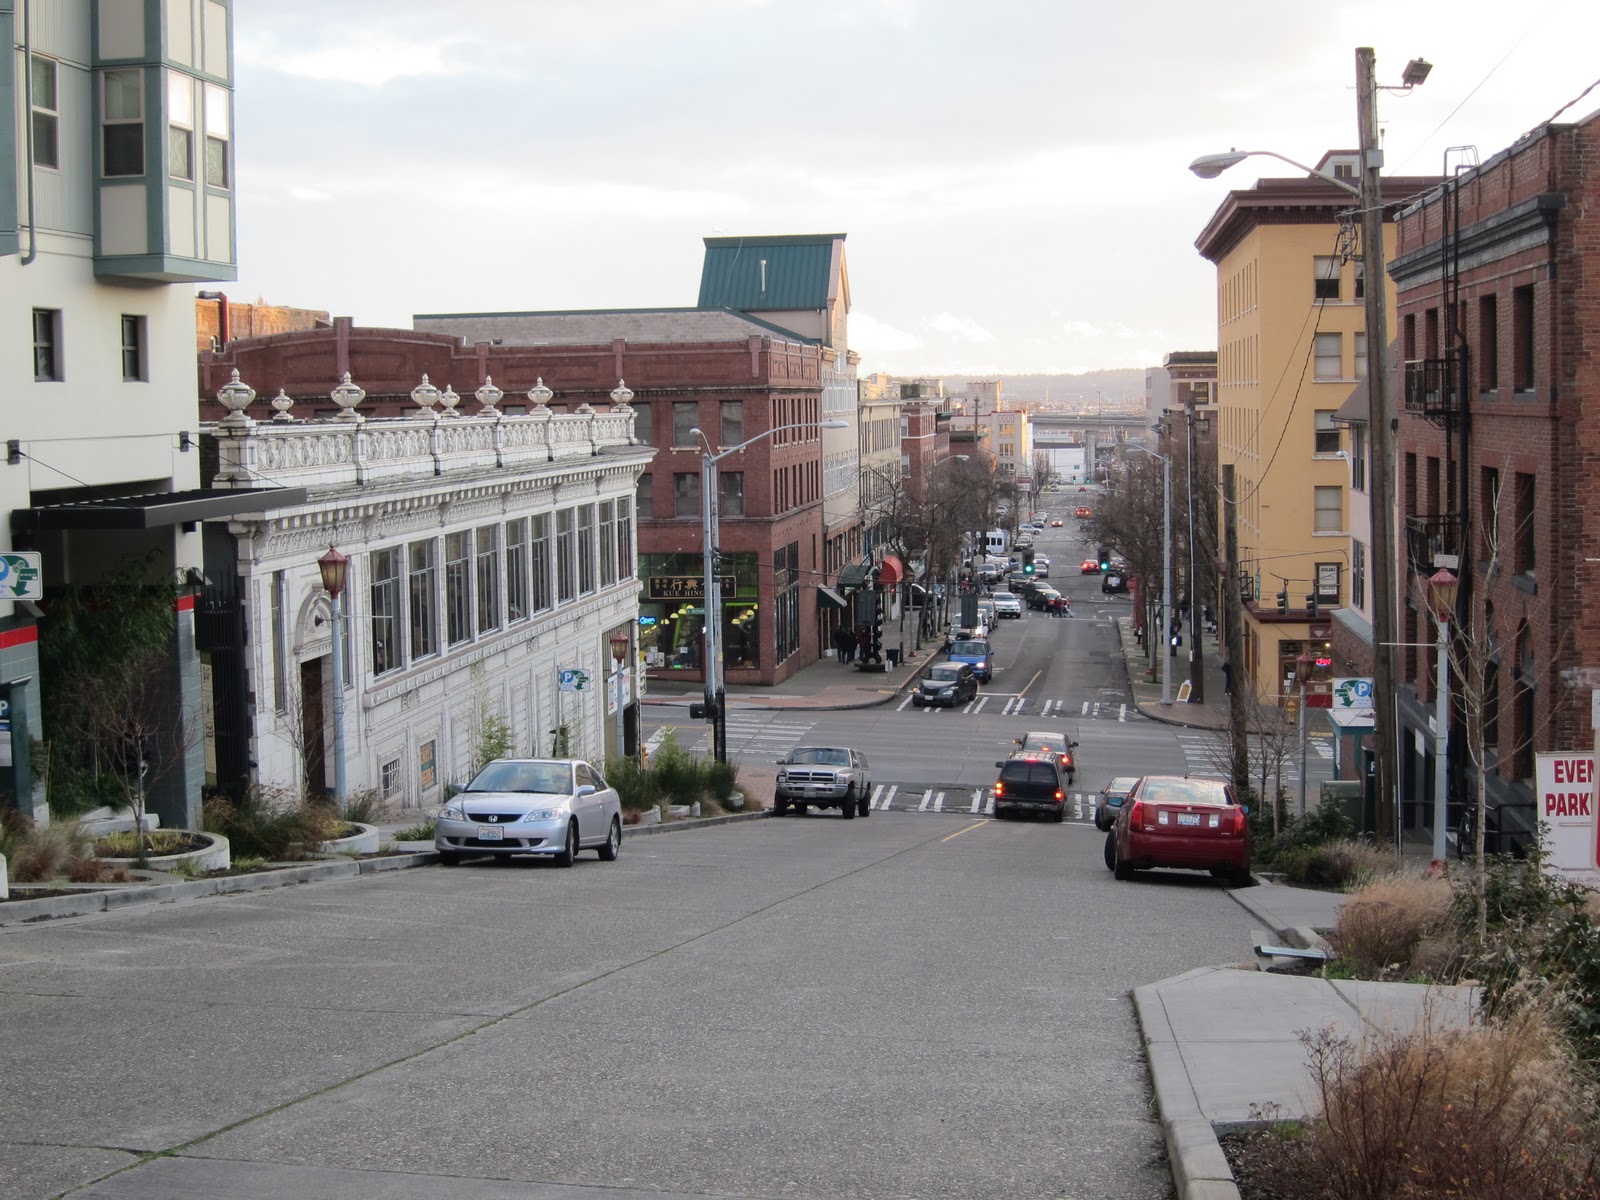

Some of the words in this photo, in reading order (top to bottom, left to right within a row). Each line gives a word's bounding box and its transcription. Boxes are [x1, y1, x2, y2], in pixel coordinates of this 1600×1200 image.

[640, 616, 655, 624] Open
[1315, 658, 1332, 666] OPEN
[1358, 683, 1369, 696] P
[1545, 792, 1592, 816] PARK
